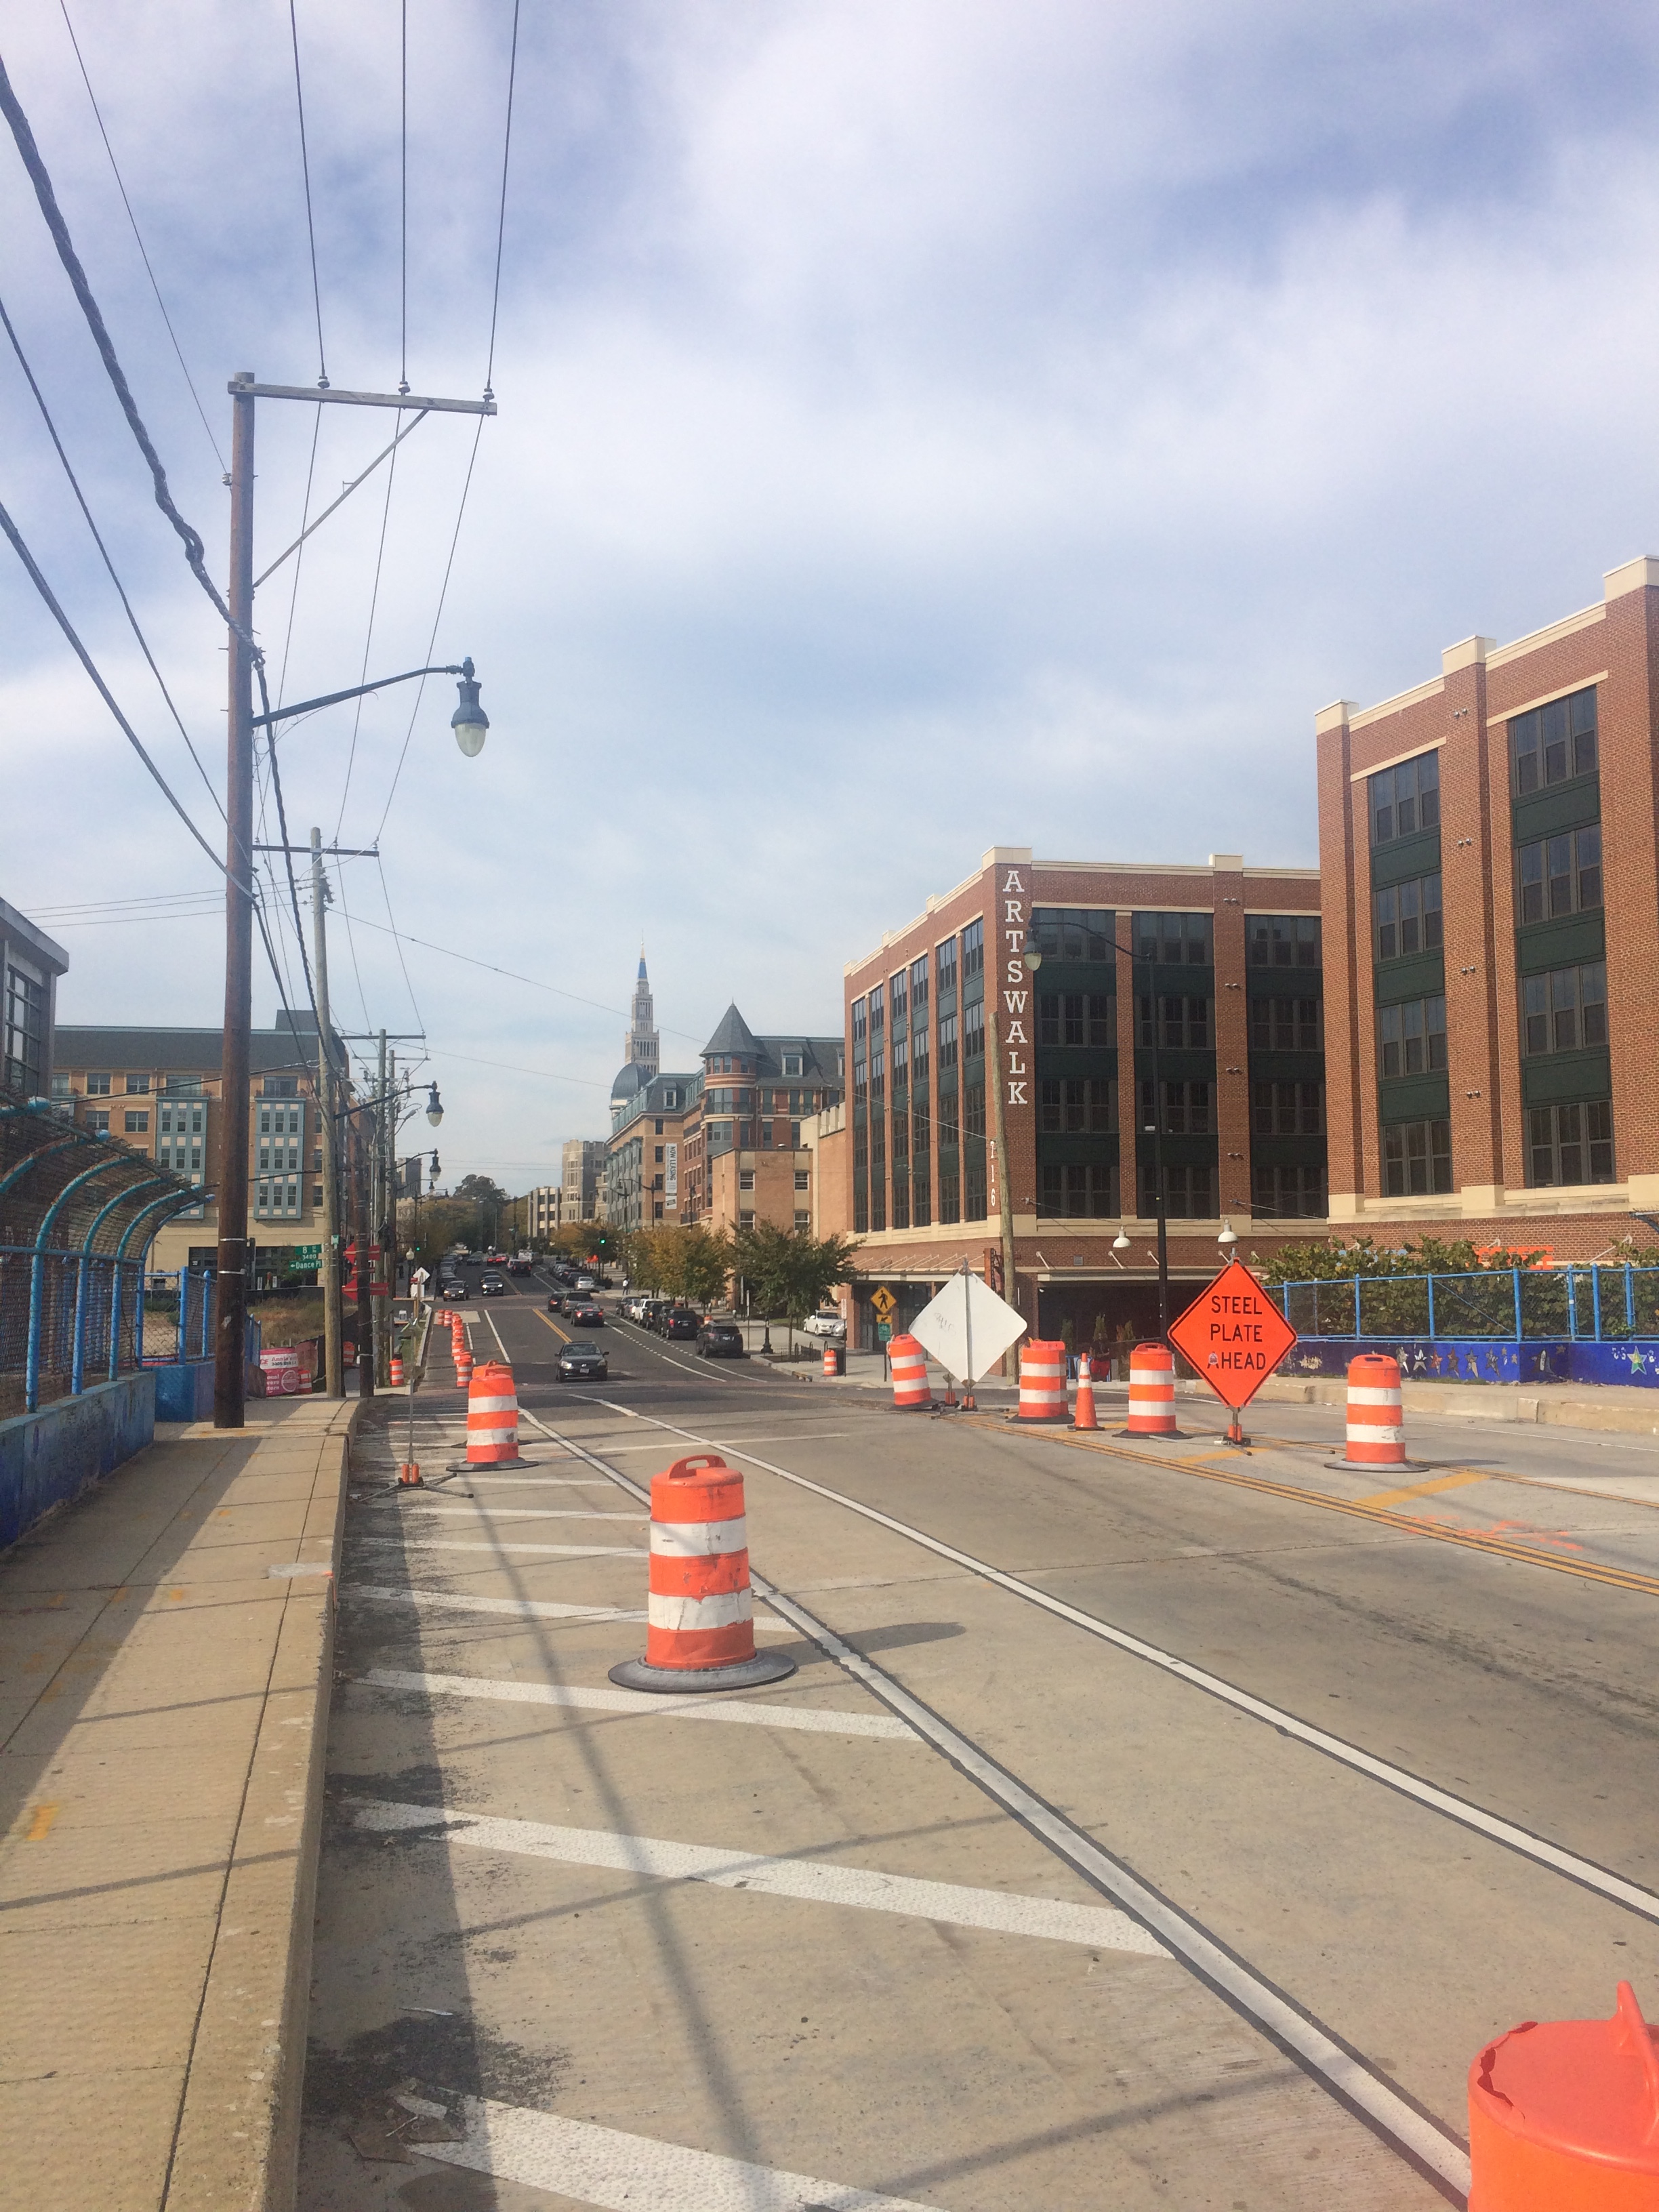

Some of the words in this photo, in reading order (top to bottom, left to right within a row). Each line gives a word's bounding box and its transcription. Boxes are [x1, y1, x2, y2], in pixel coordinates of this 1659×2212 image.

[1002, 870, 1028, 1105] ARTSWALK
[1211, 1295, 1263, 1315] STEEL
[1210, 1323, 1263, 1343] PLATE
